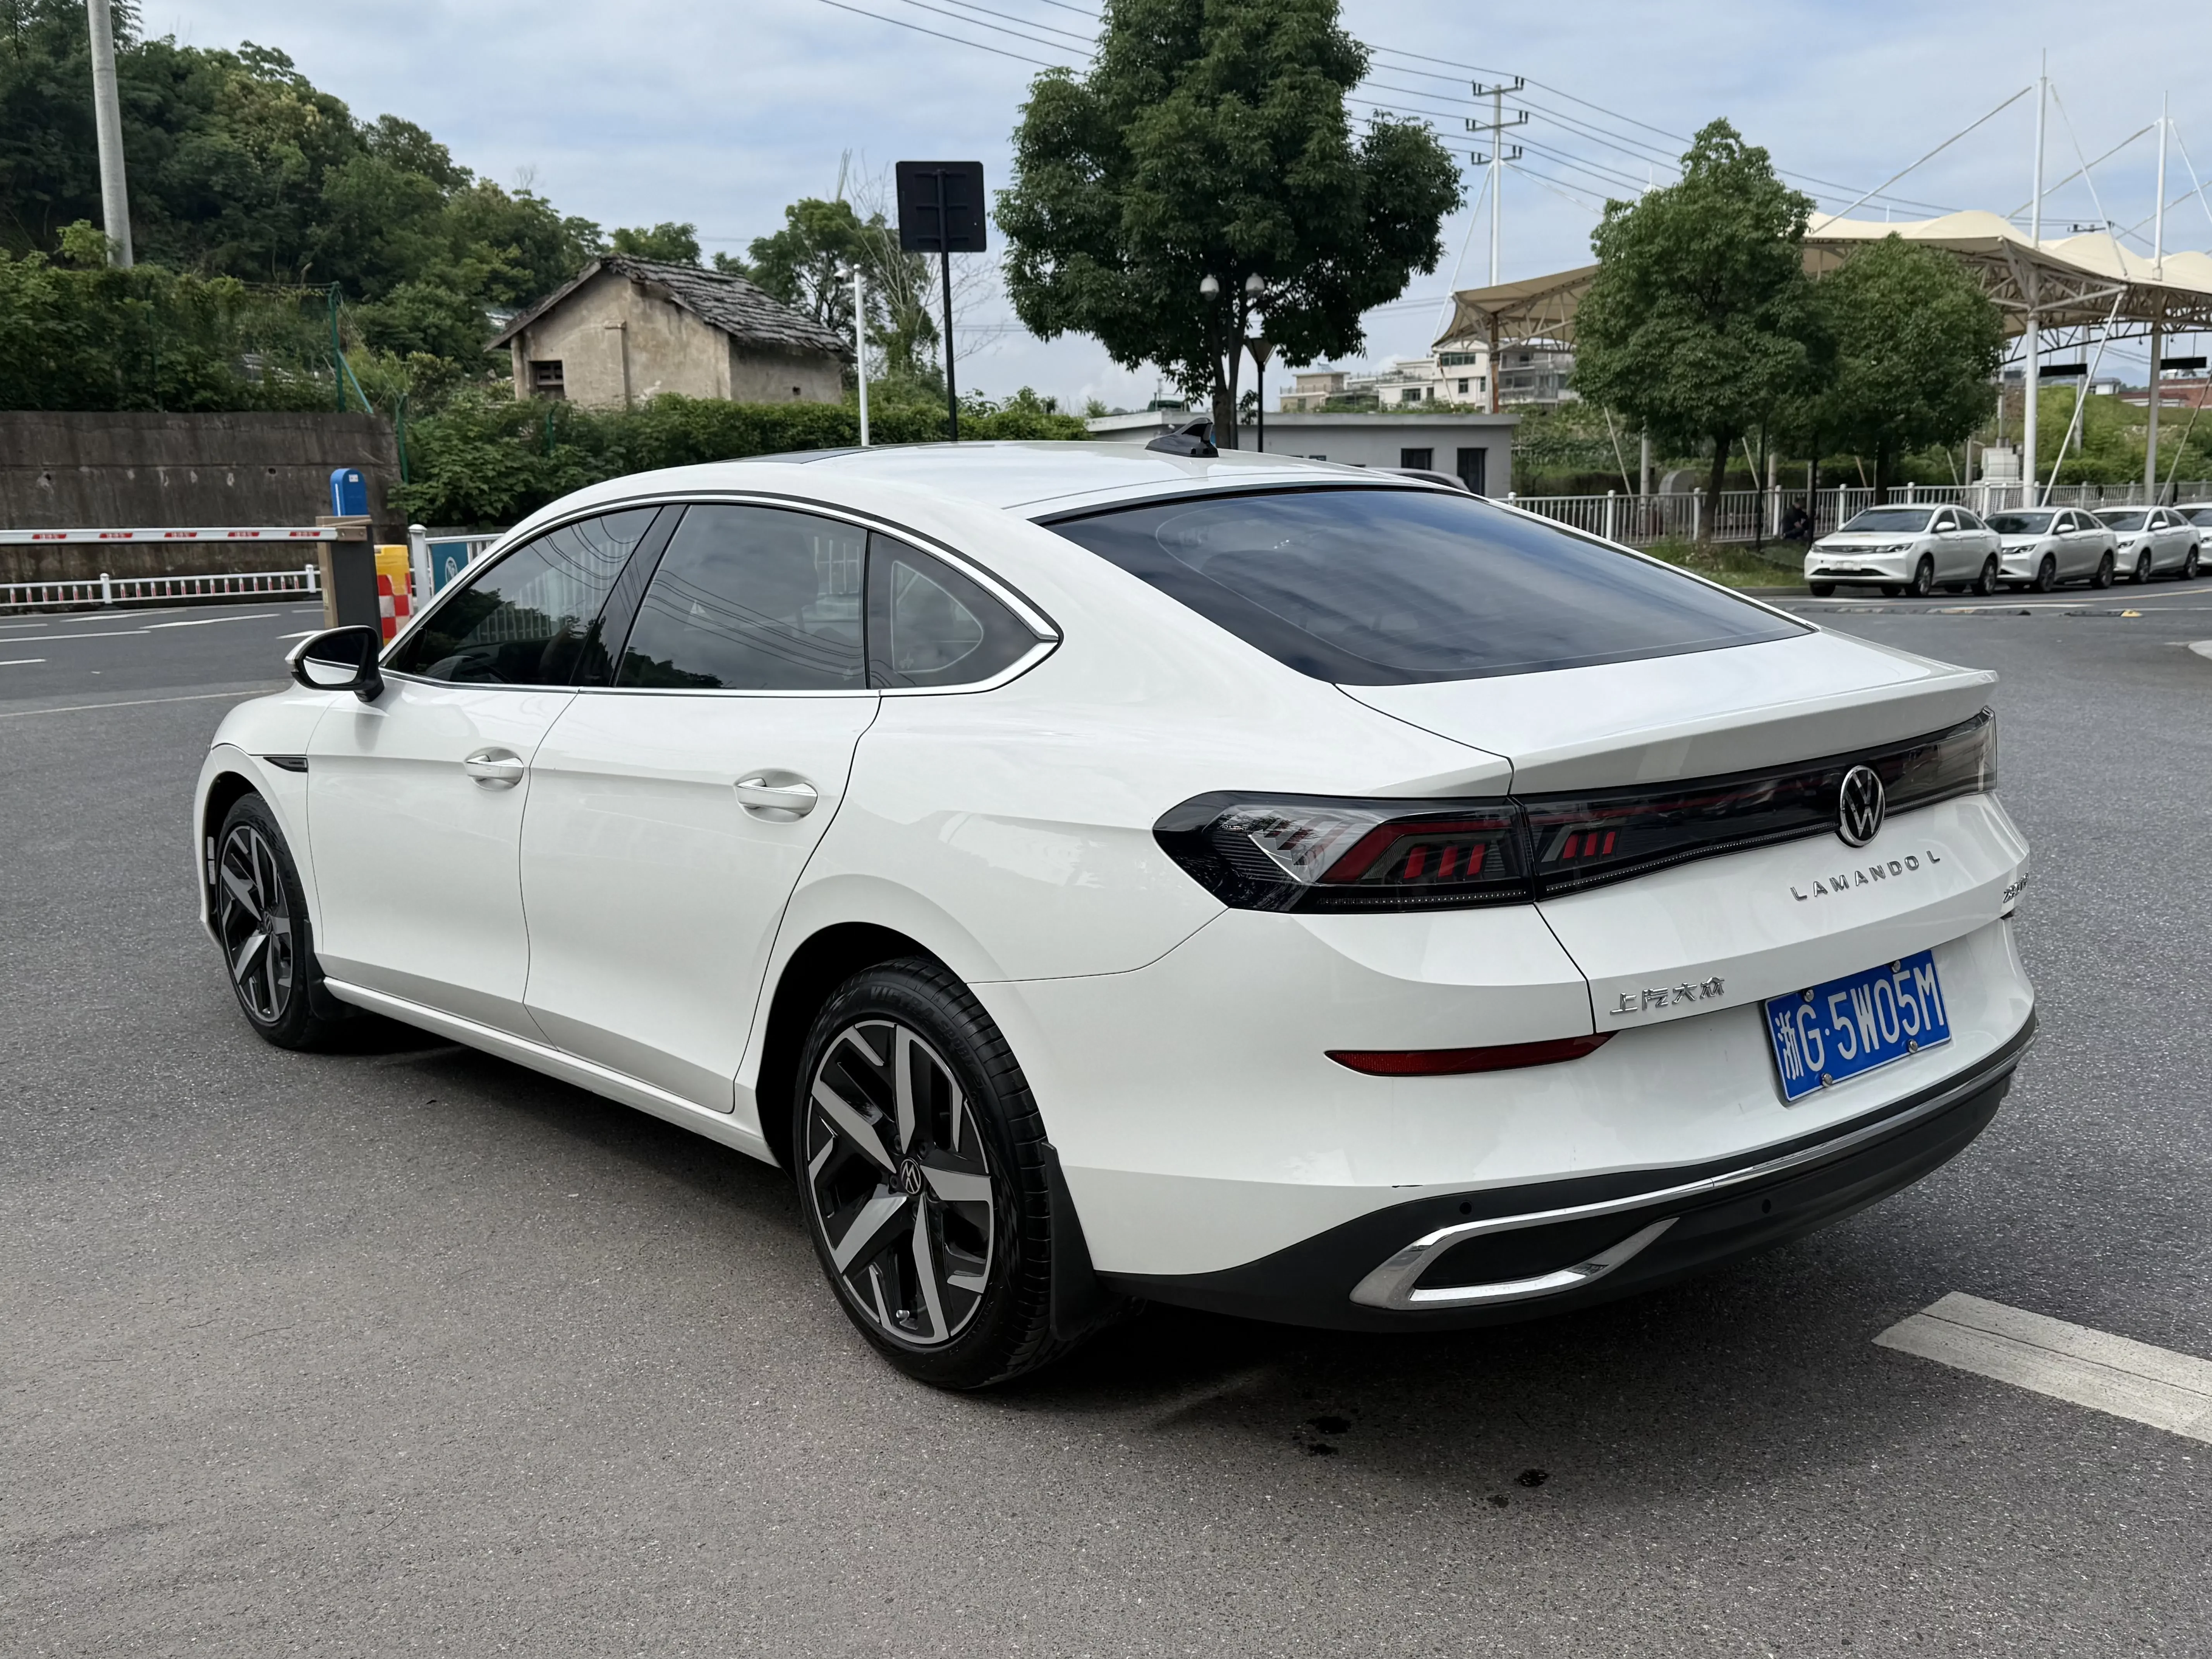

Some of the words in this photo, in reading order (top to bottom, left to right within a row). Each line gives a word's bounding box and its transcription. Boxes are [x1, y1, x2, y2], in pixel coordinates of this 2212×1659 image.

[1790, 855, 1919, 902] LAMANDO
[1926, 850, 1941, 864] L
[1609, 976, 1725, 1015] 上汽大众
[1775, 963, 1944, 1080] 浙G·5W05M
